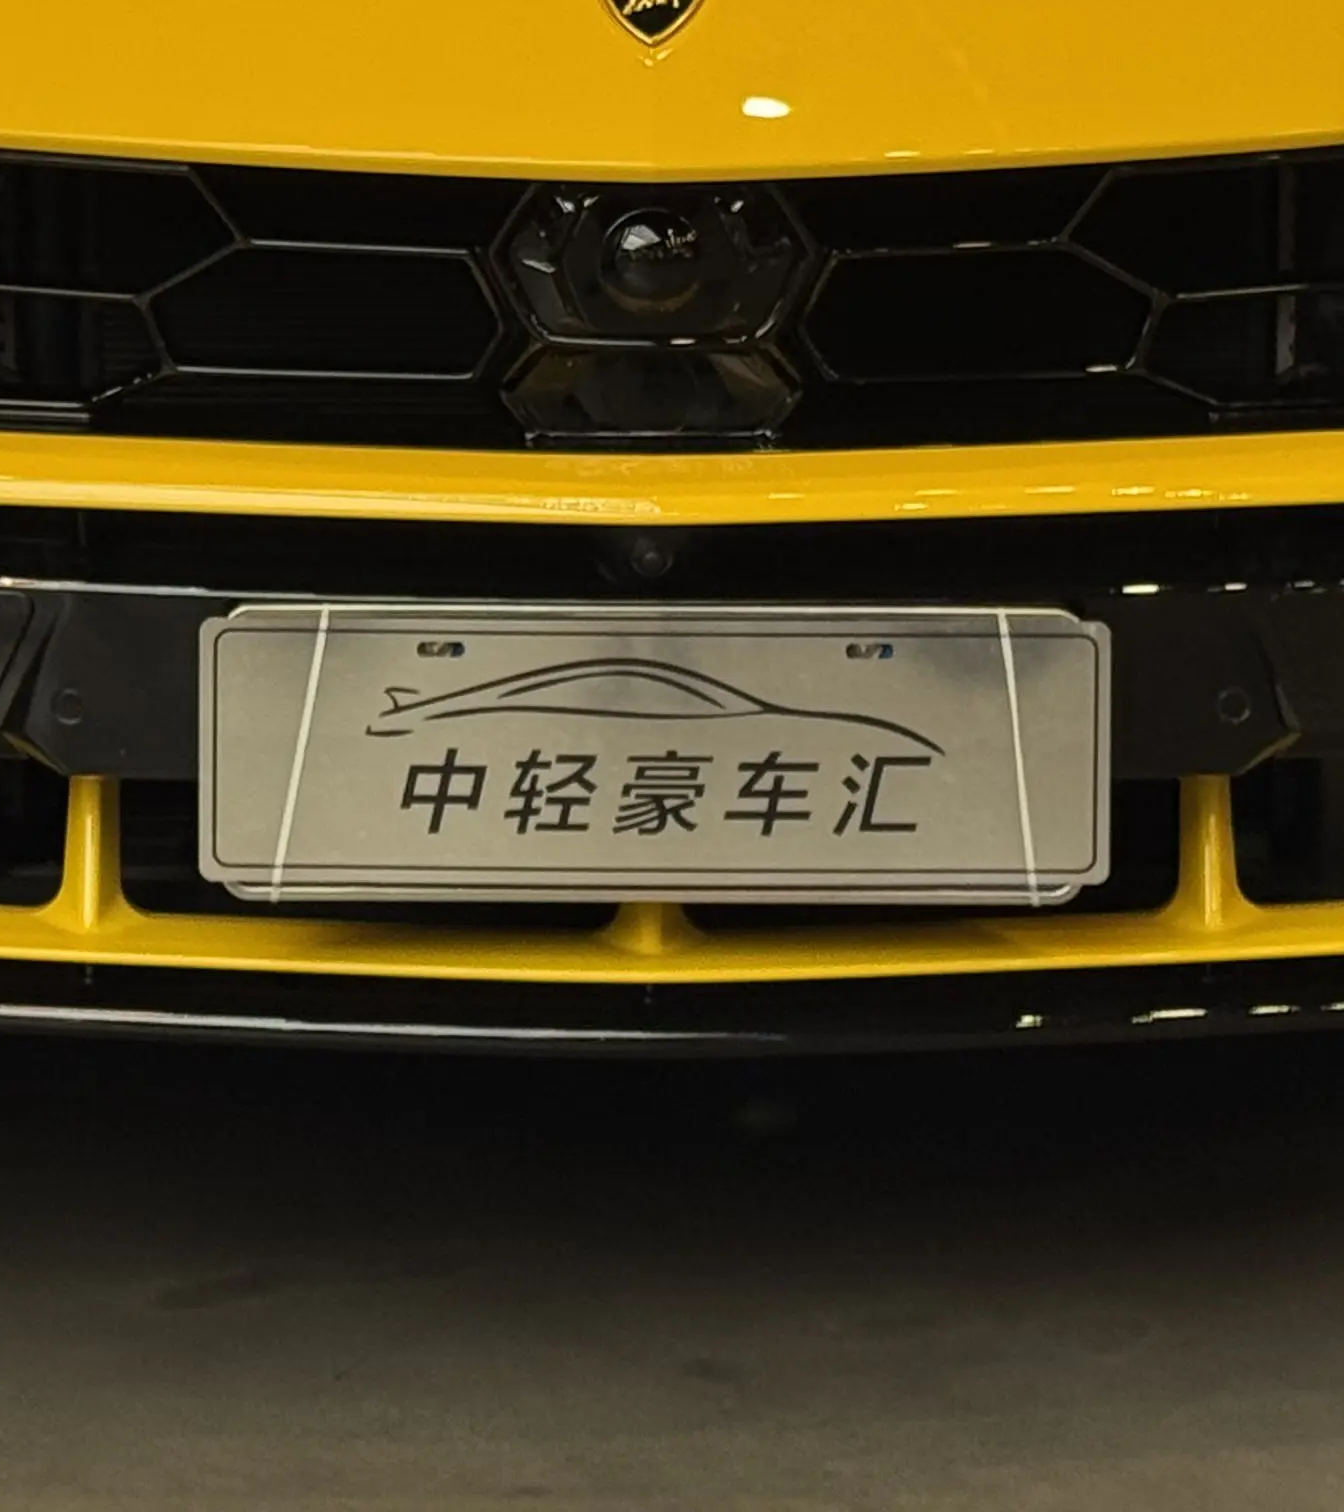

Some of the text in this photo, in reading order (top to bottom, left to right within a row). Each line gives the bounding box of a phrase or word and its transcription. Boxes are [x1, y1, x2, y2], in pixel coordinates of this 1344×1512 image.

[400, 748, 934, 836] 中轻豪车汇
